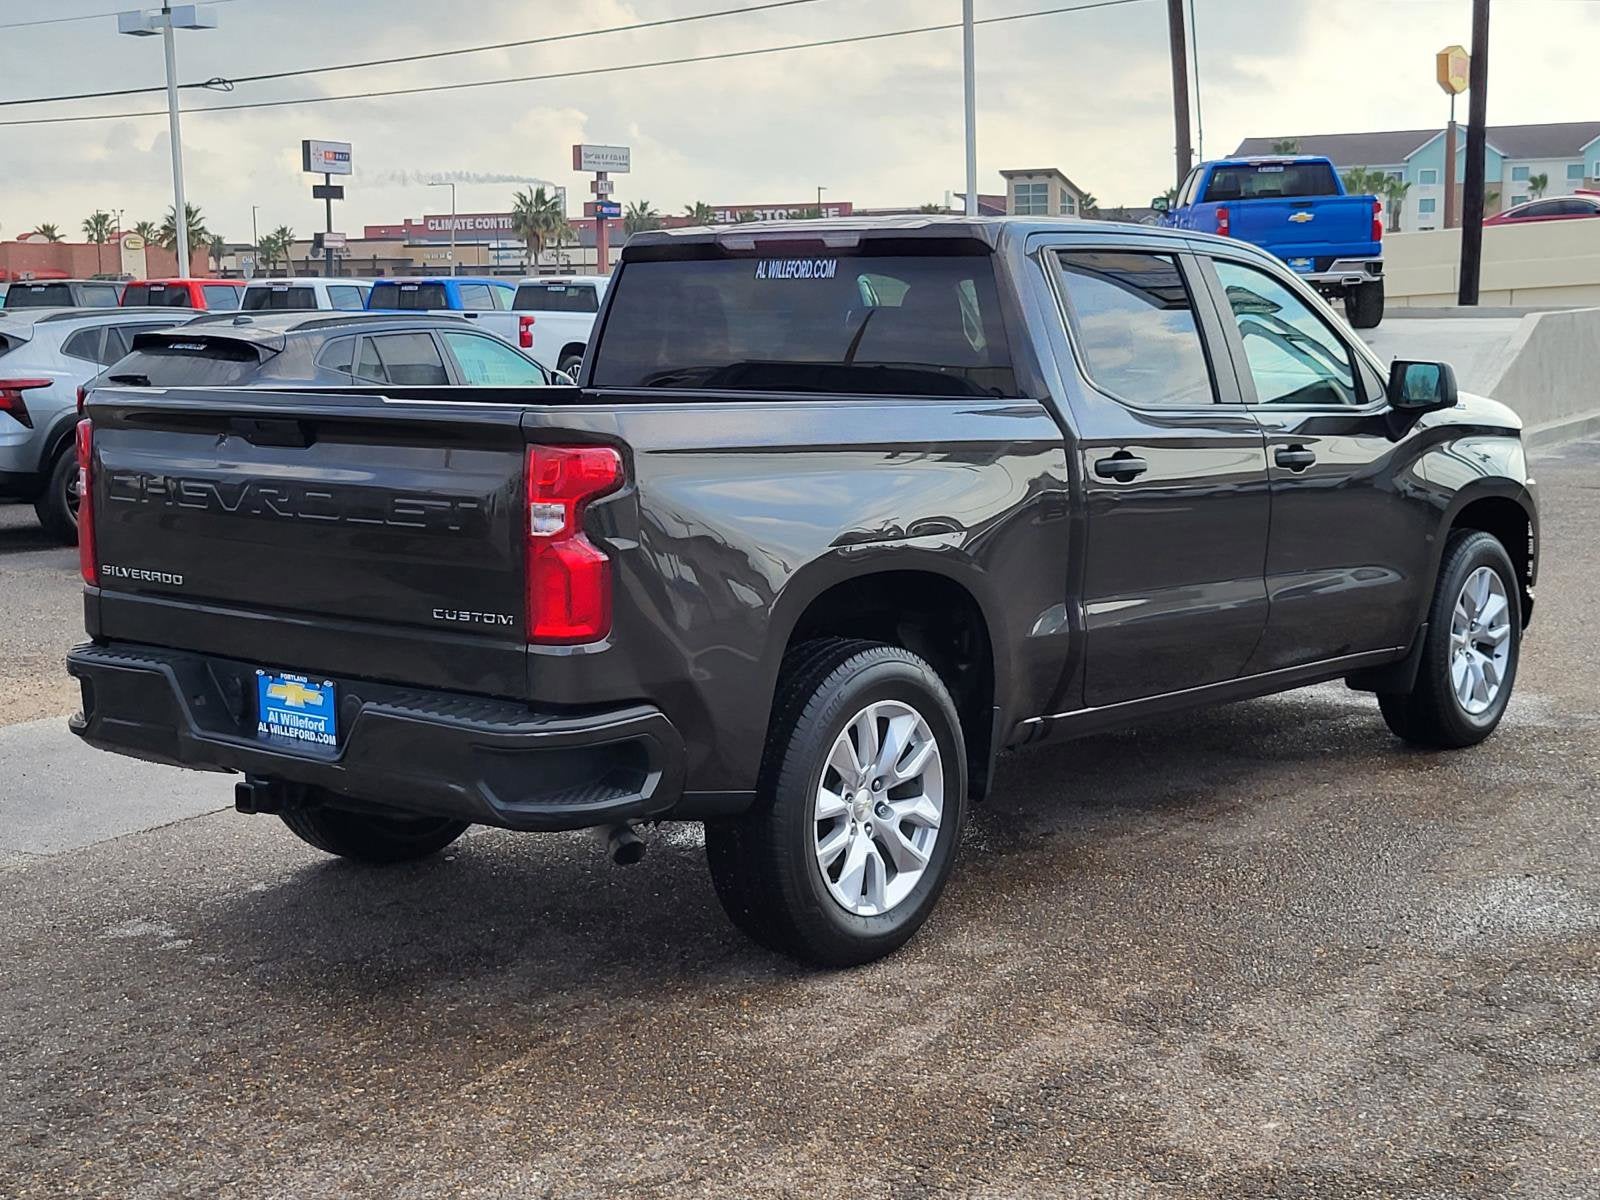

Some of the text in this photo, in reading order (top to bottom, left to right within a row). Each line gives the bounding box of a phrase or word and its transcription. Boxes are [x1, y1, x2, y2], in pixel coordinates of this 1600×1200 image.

[428, 218, 473, 230] CLIMATE
[755, 259, 837, 279] AL WILLEFORD.COM
[101, 564, 184, 585] SILVERADO
[432, 608, 514, 626] CUSTOM
[280, 673, 308, 683] PORTLAND
[268, 710, 325, 732] Al Willeford
[257, 721, 337, 746] AL WILLEFORD.COM
